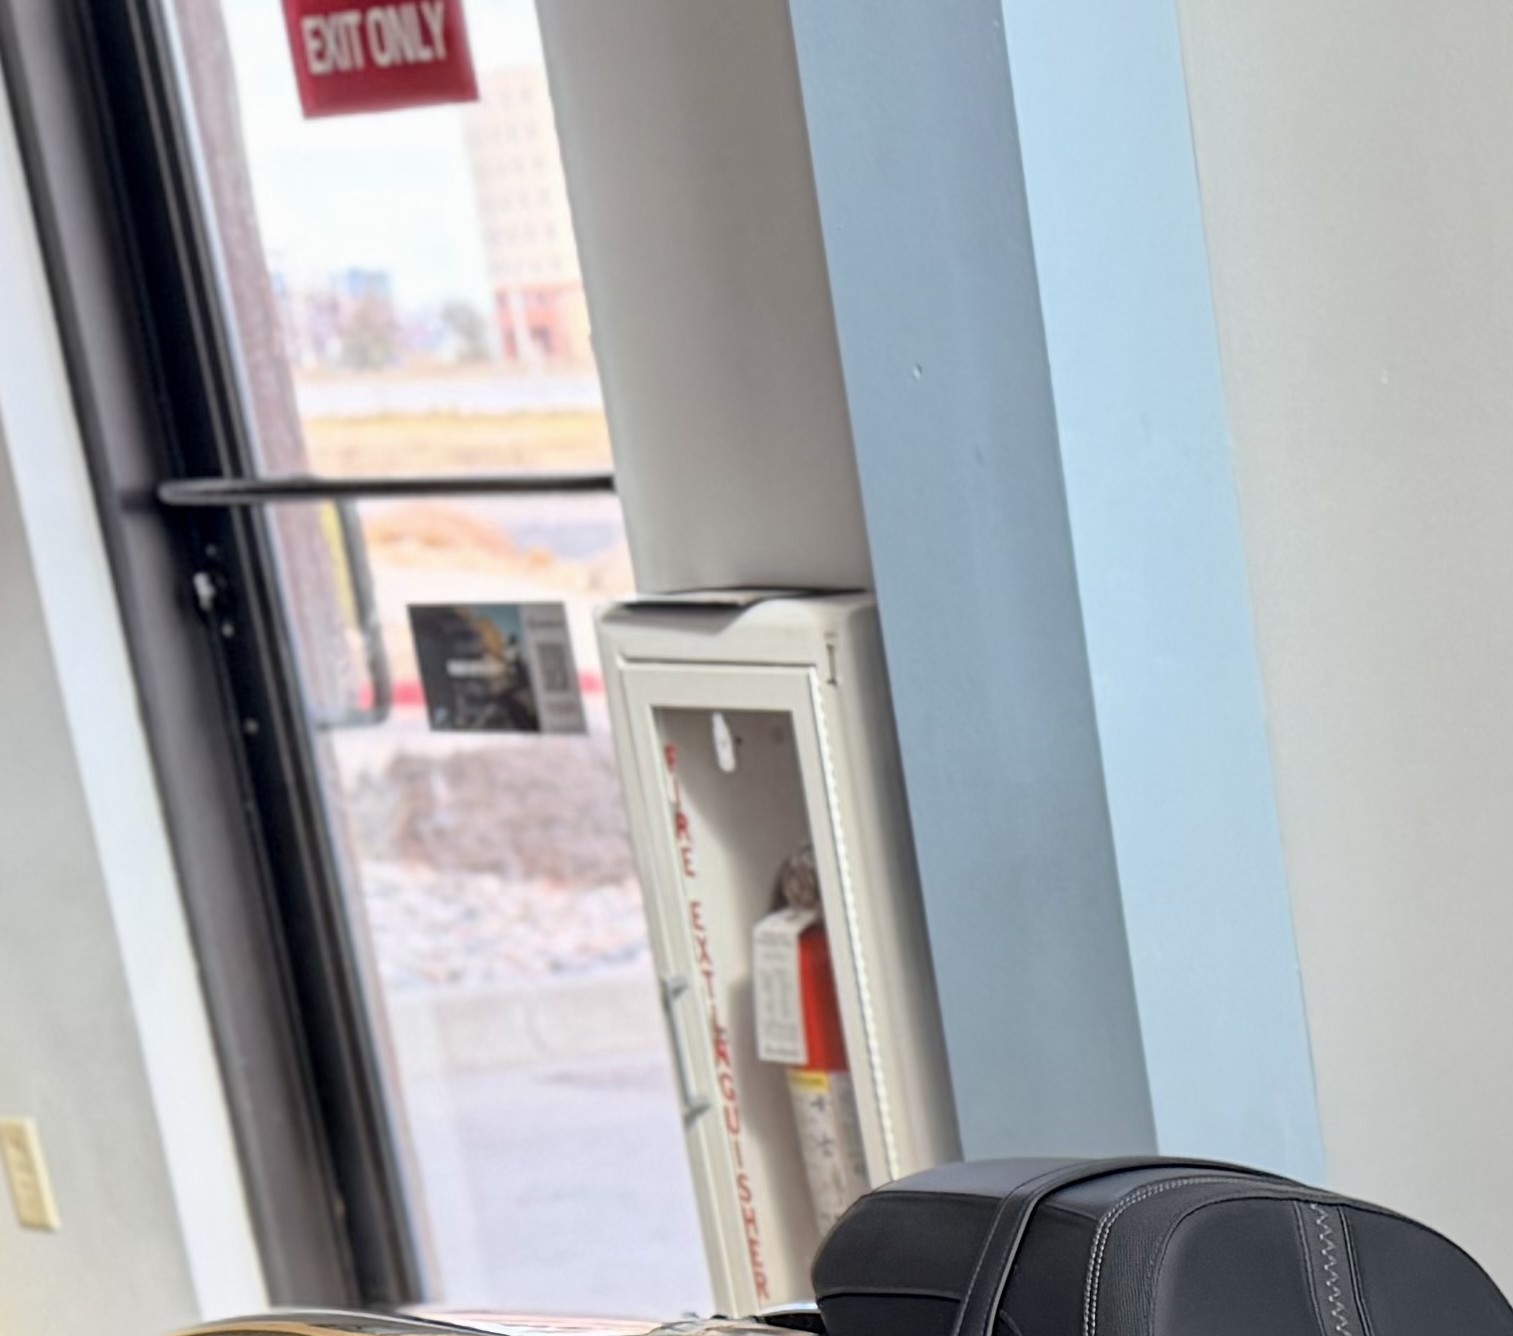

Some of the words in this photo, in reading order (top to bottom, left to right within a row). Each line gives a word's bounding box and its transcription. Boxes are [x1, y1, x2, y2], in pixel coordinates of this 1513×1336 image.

[302, 11, 364, 76] EXIT
[366, 0, 447, 68] ONLY
[663, 743, 696, 878] FIRE
